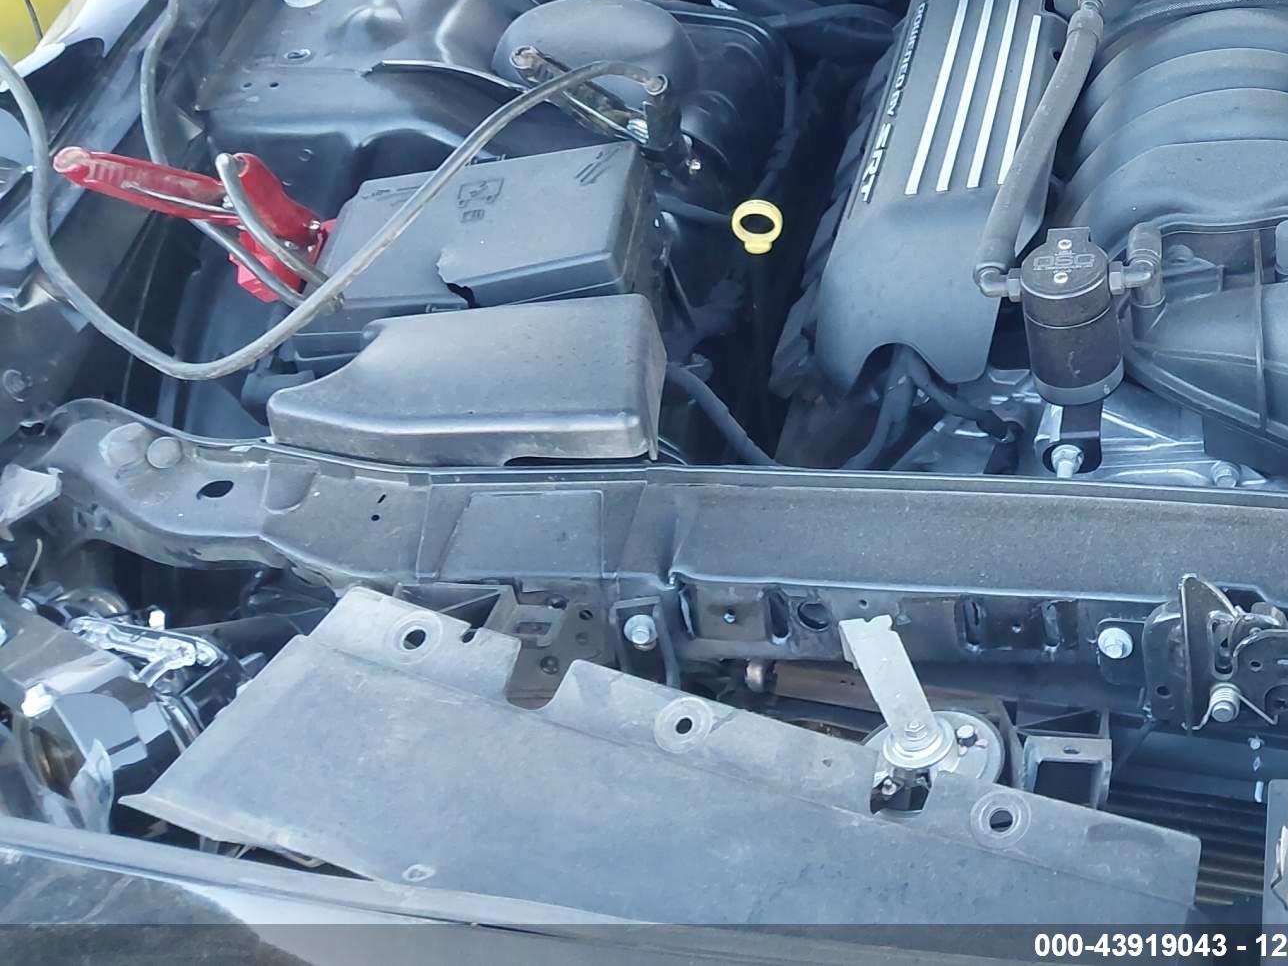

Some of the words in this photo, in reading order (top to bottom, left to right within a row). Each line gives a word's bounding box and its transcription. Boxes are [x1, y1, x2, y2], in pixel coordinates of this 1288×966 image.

[896, 2, 926, 89] POWERED
[887, 89, 904, 116] BY
[860, 122, 892, 203] SRT
